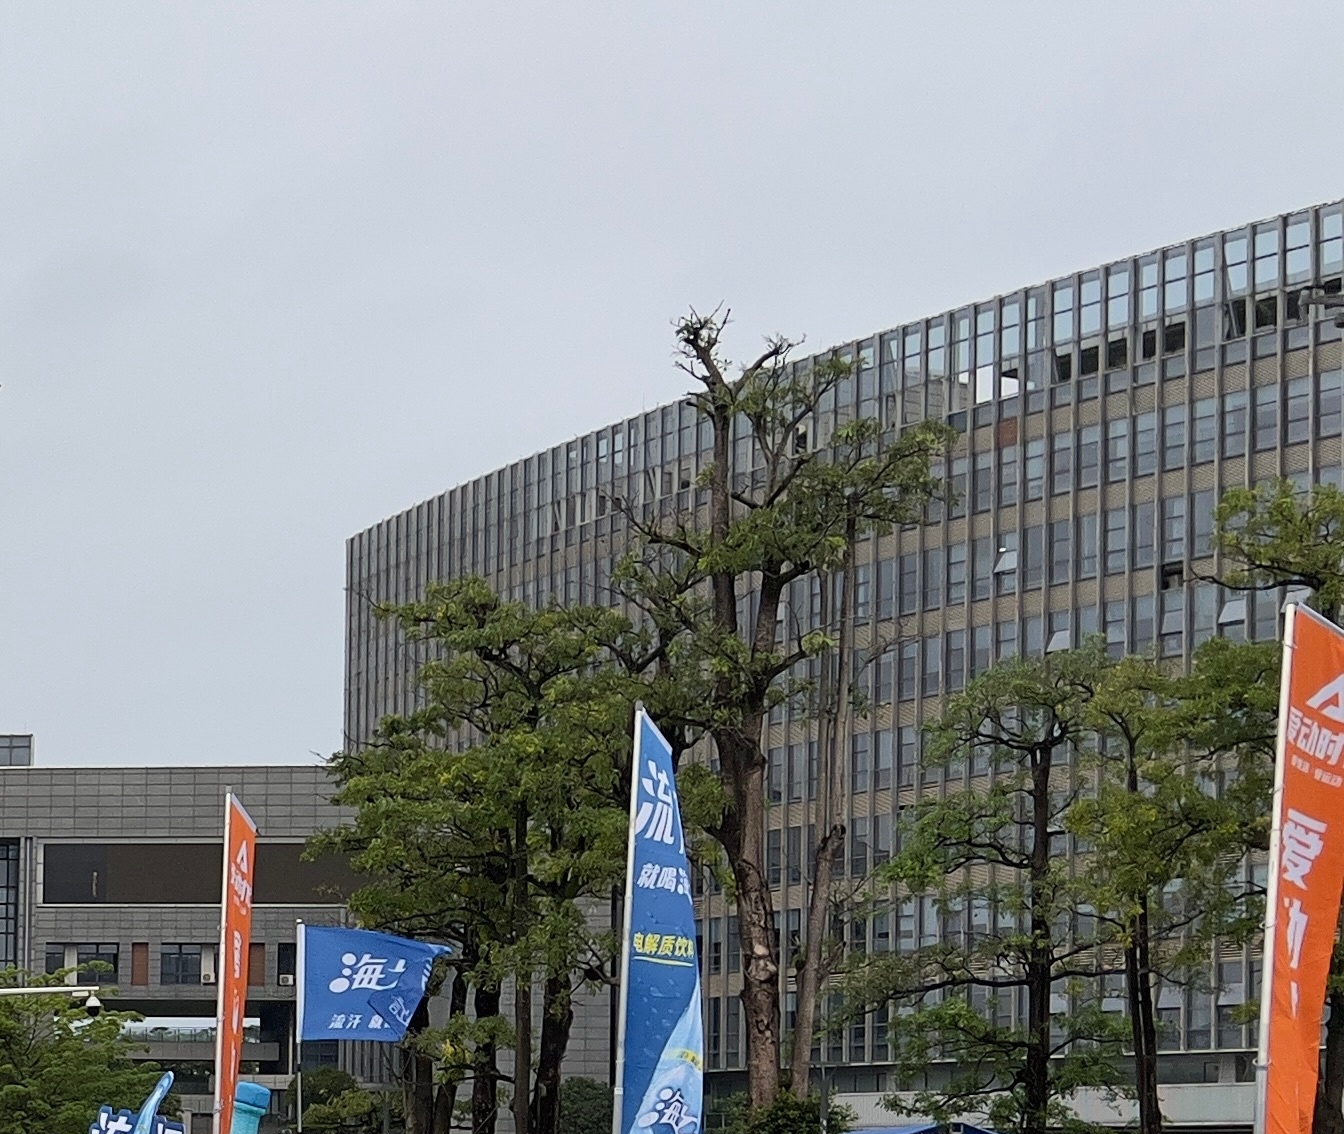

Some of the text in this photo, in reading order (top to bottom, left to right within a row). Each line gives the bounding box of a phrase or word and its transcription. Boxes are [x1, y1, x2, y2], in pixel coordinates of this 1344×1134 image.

[1287, 706, 1344, 765] 爱动时
[635, 760, 684, 854] 流
